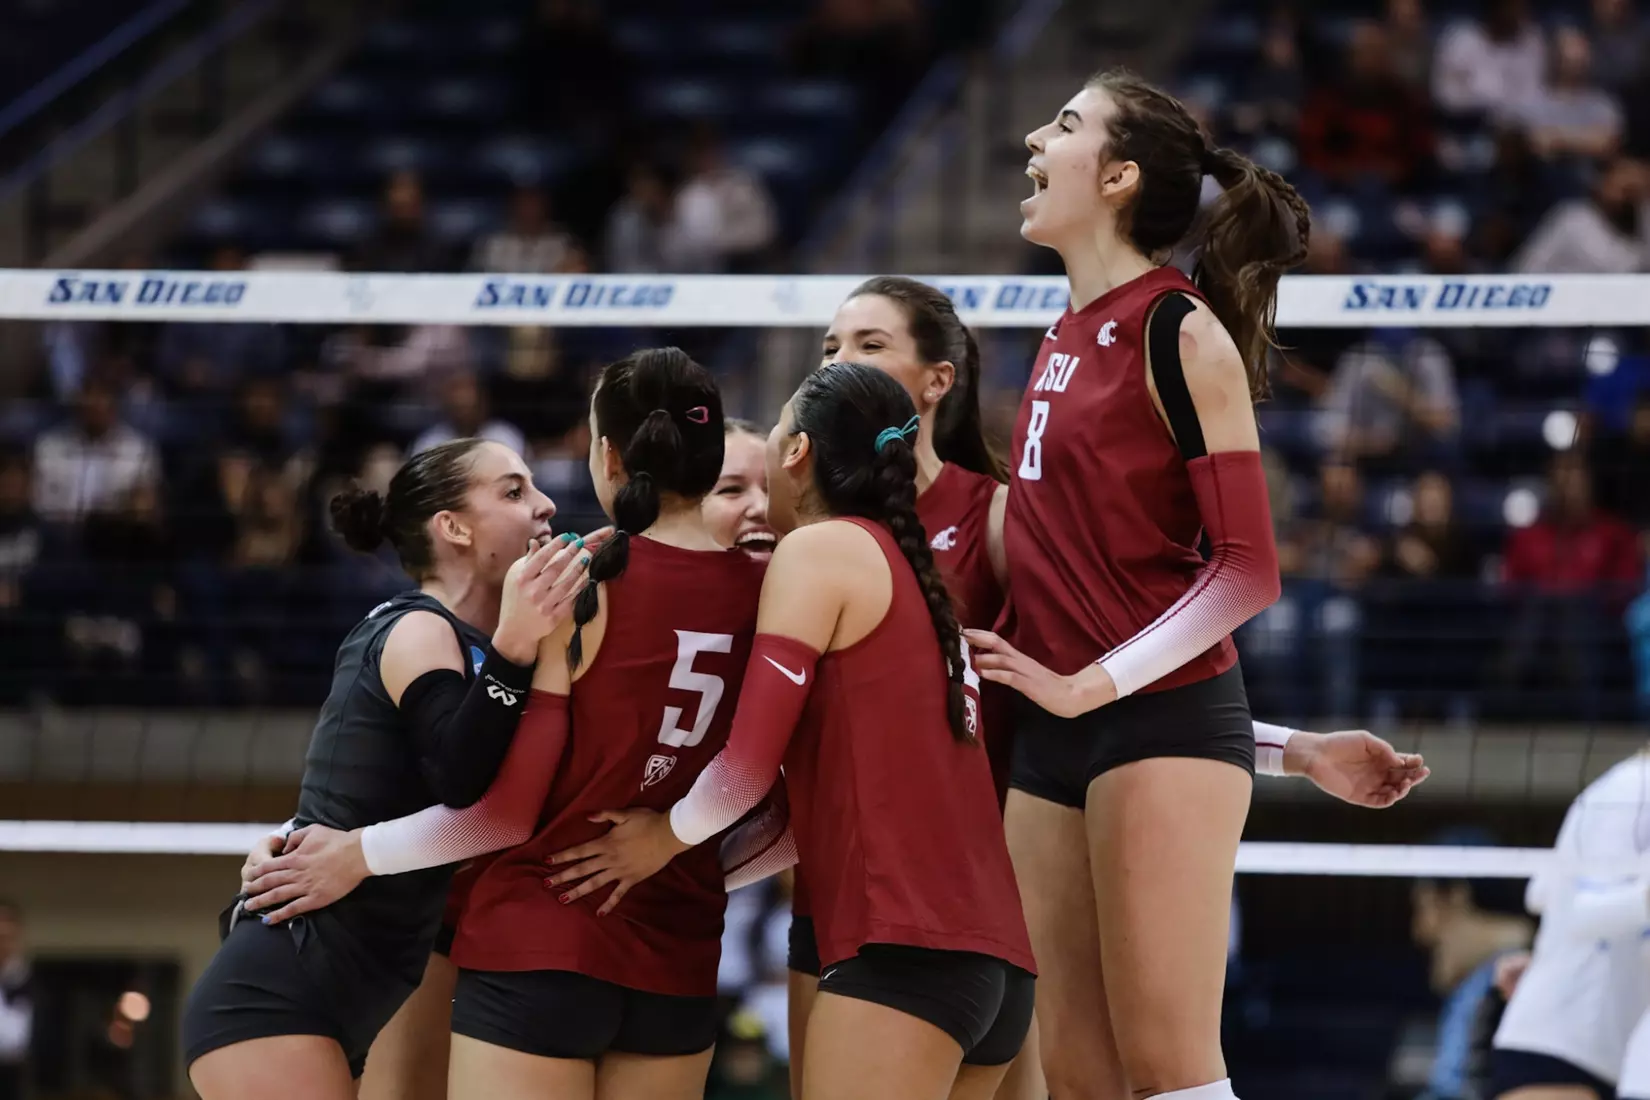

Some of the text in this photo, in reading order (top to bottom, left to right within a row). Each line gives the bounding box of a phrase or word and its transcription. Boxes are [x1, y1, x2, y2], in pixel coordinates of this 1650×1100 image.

[46, 273, 248, 305] SAN DIEGO
[472, 277, 676, 309] SAN DIEGO
[994, 280, 1069, 311] DIE
[1343, 278, 1552, 311] SAN DIEGO
[1018, 400, 1050, 481] 8
[657, 629, 734, 748] 5
